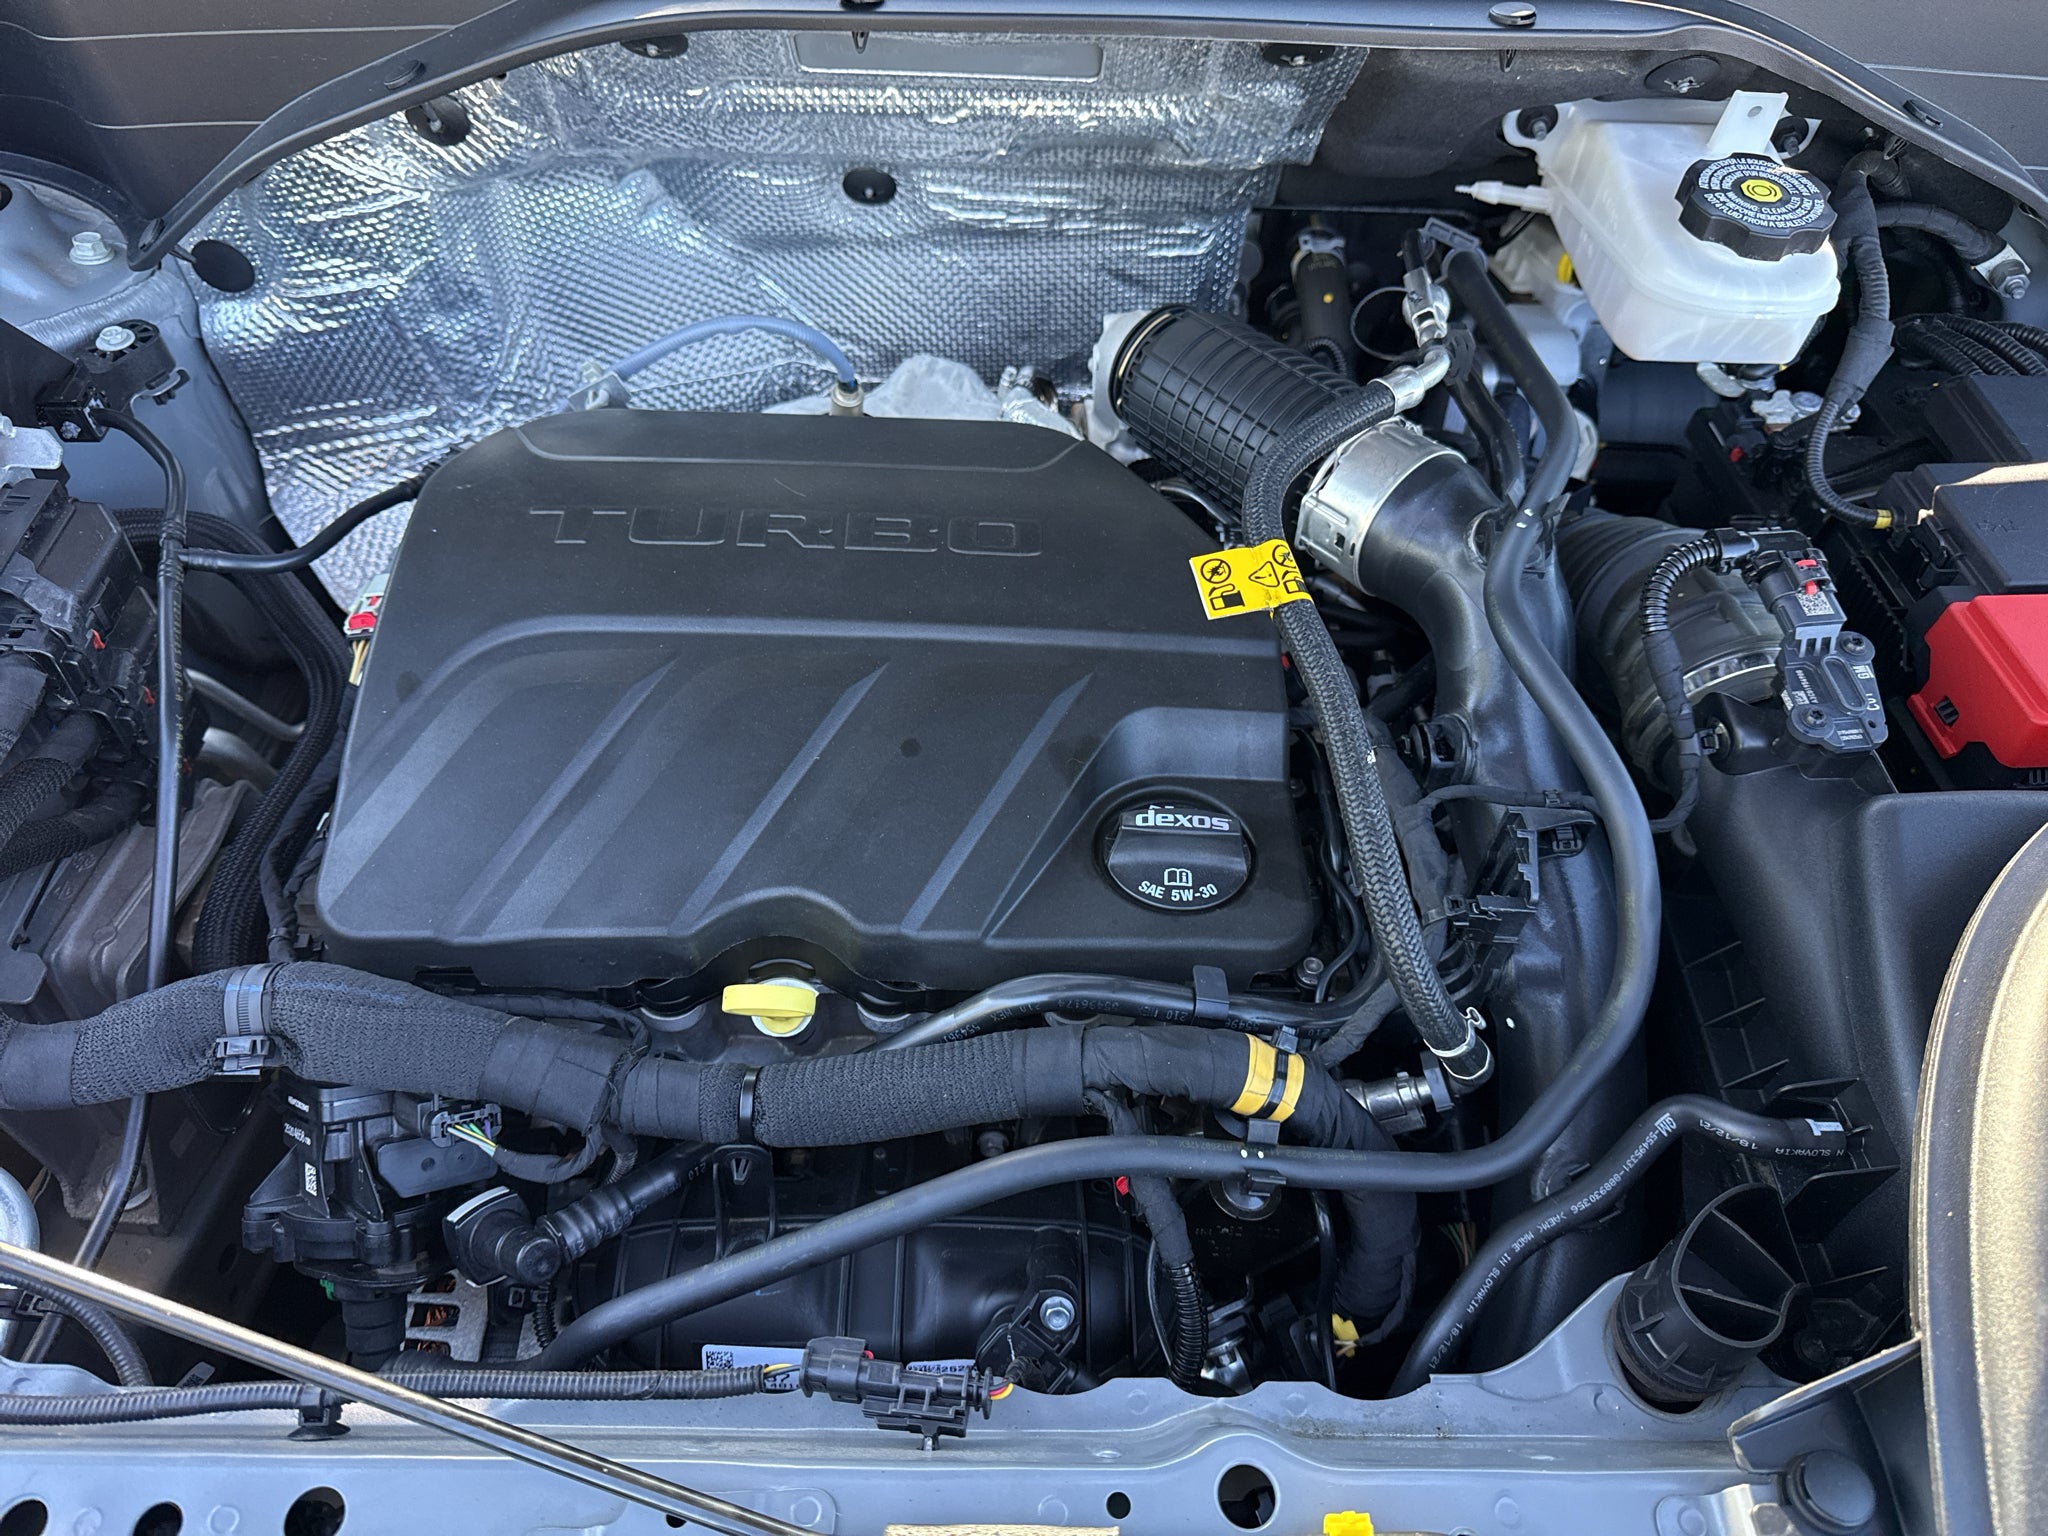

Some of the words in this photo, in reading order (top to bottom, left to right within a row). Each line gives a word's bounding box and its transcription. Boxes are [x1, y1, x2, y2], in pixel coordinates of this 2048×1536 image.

[1720, 205, 1743, 220] FLUID
[1742, 216, 1768, 227] FROM
[1761, 206, 1788, 215] CLEAN
[528, 507, 1044, 557] TURBO
[1852, 665, 1874, 679] GM
[1135, 809, 1231, 831] dexos
[1138, 880, 1166, 899] SAE
[1170, 883, 1219, 902] 5W-30
[1774, 1146, 1832, 1157] SLOVAKIA
[1511, 1230, 1536, 1254] MADE
[1497, 1252, 1512, 1267] IN
[1466, 1267, 1502, 1315] SLOVAKIA
